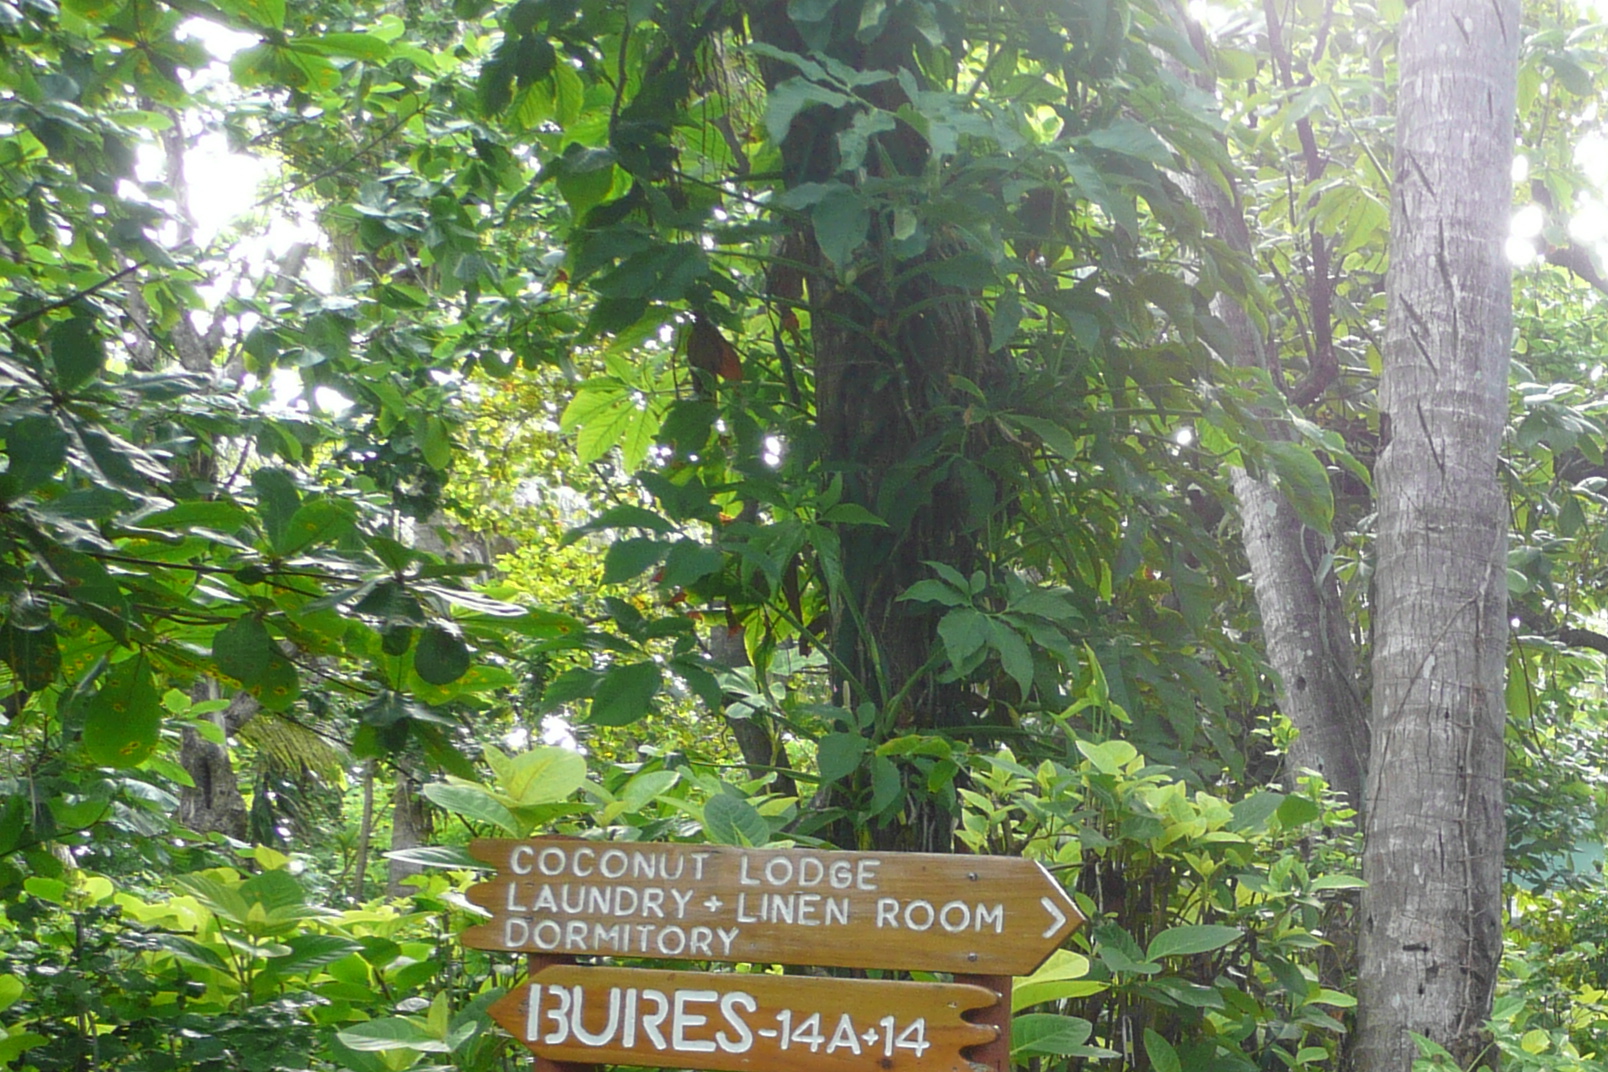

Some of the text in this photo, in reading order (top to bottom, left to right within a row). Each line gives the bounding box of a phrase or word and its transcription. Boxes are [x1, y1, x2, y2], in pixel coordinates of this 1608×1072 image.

[509, 846, 881, 891] COCONUT LODGE
[507, 882, 693, 918] LAUNDRY
[737, 893, 850, 926] LINEN
[877, 898, 1003, 934] ROOM
[505, 919, 741, 956] DORMITORY
